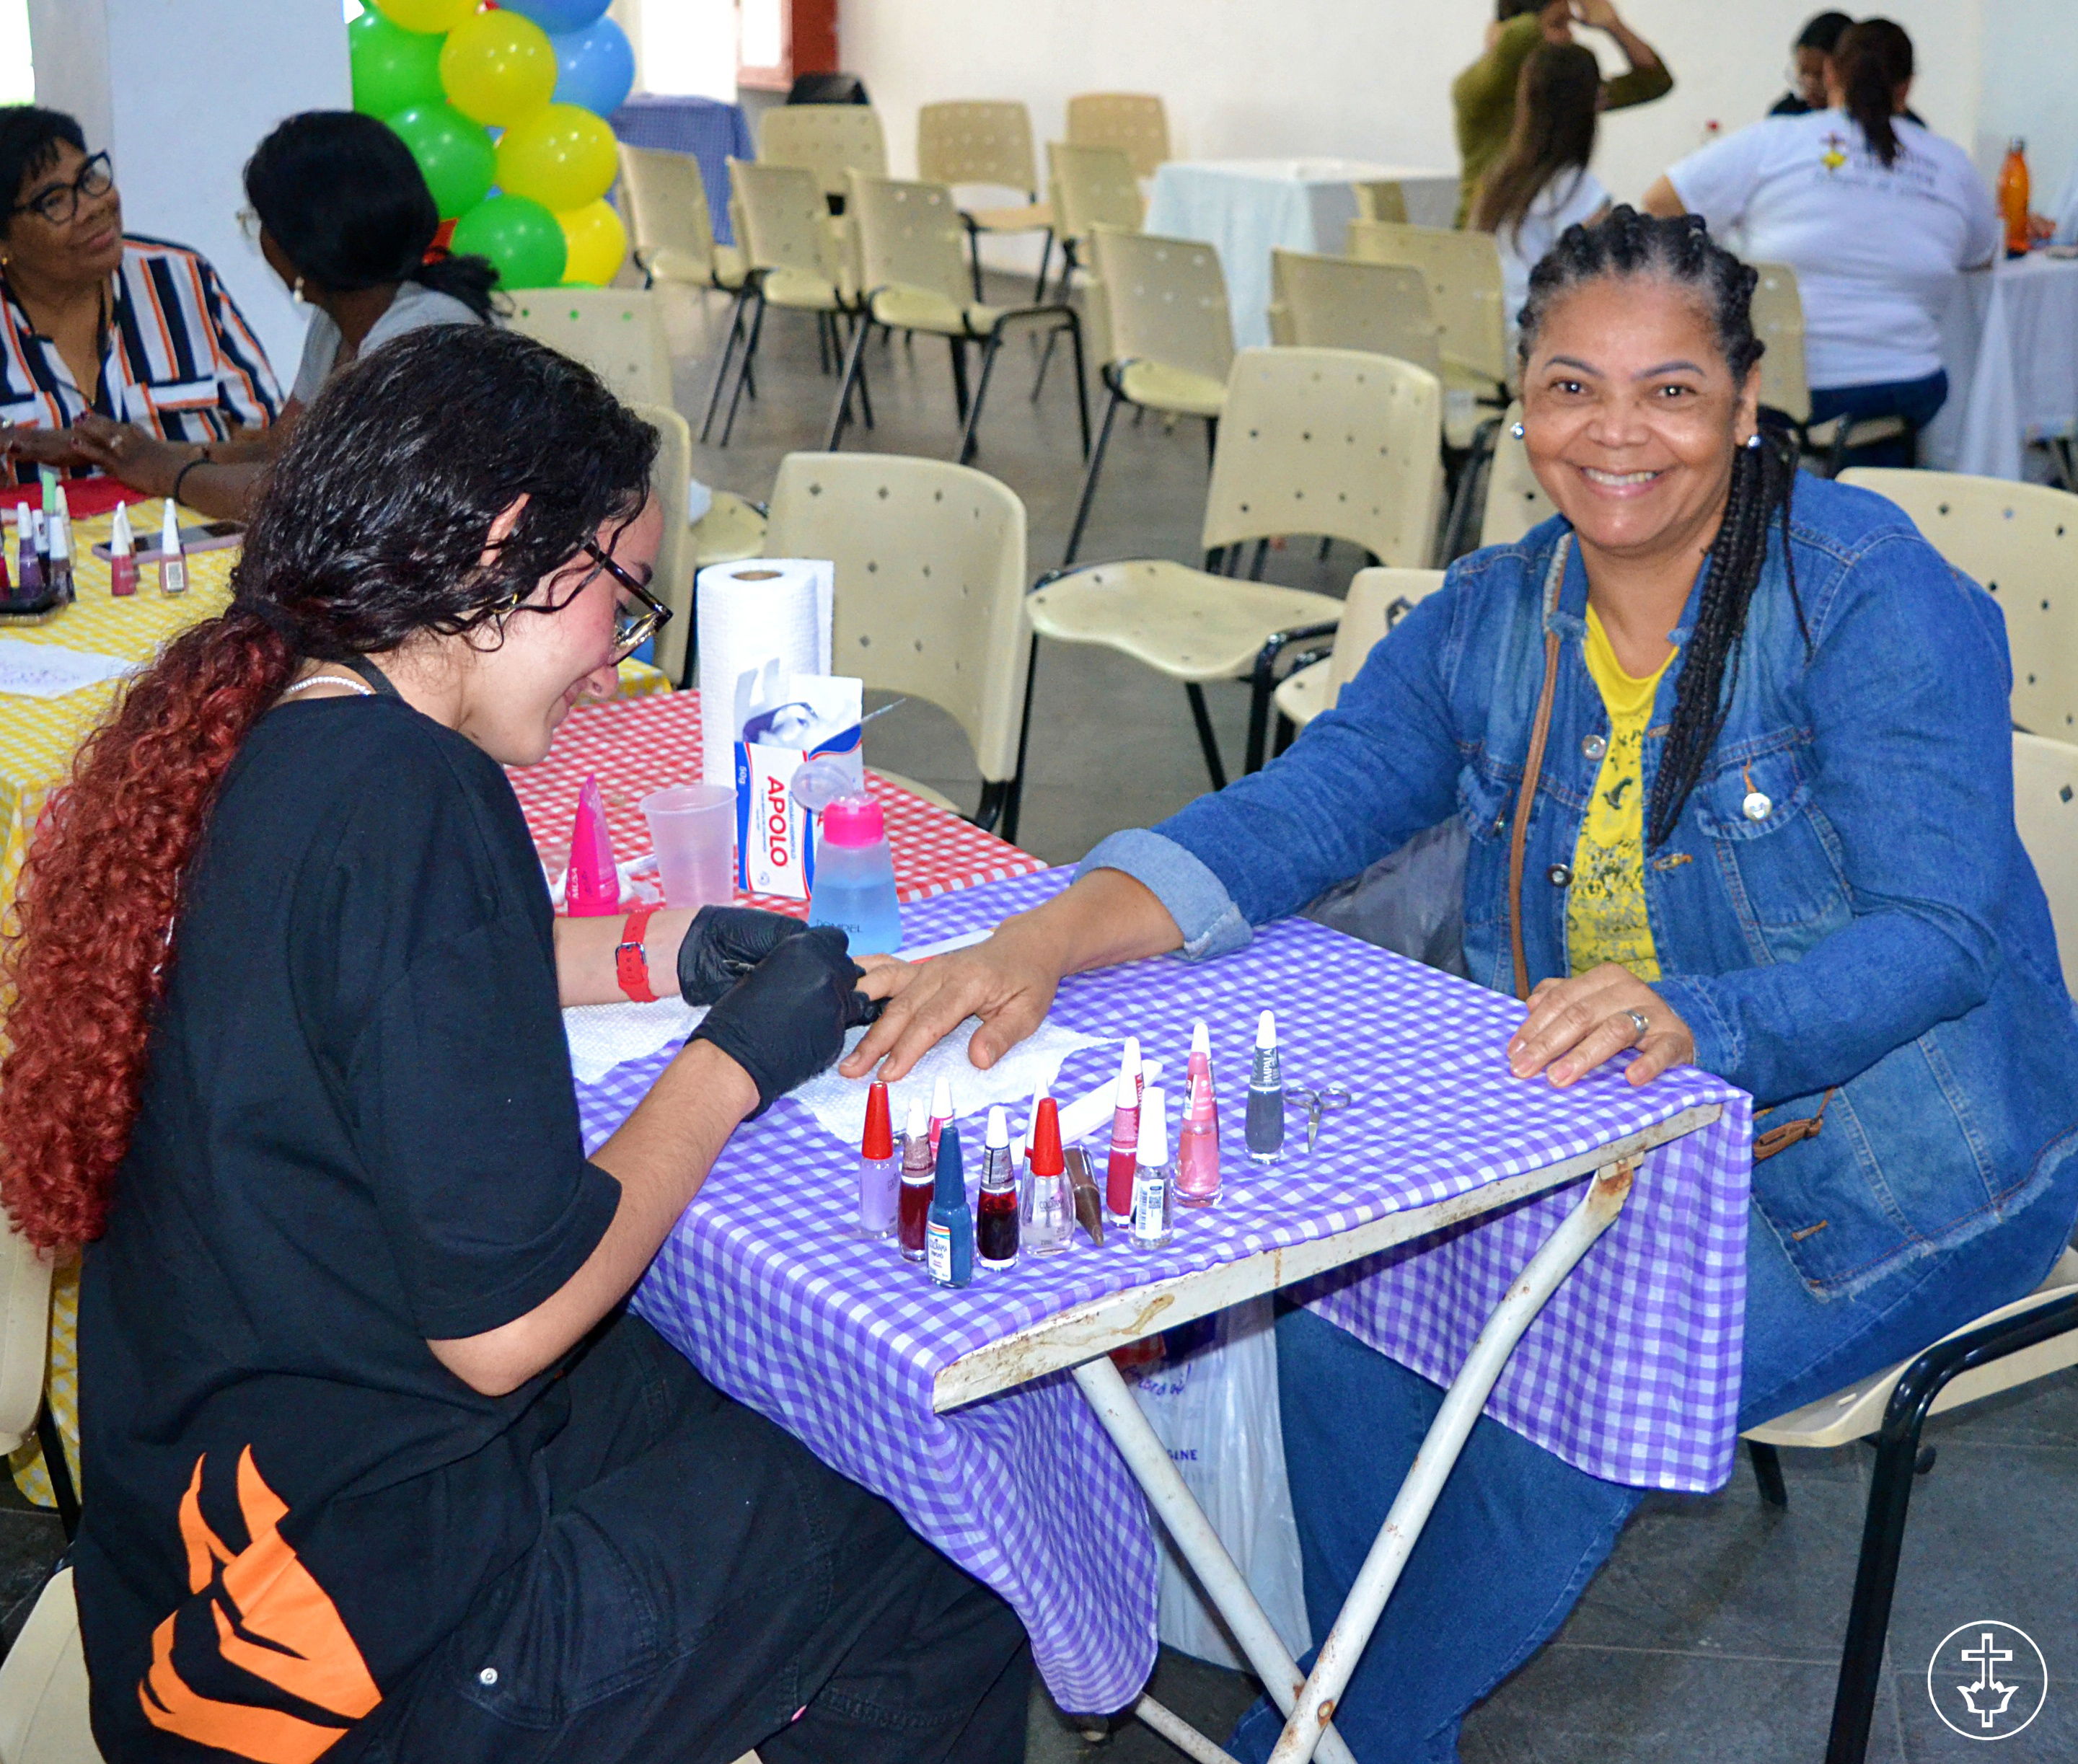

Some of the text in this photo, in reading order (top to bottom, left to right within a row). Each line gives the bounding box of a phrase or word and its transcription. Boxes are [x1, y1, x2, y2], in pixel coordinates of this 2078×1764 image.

[739, 766, 747, 785] 50g
[767, 775, 788, 867] APOLO
[1263, 1049, 1274, 1082] IMPALA
